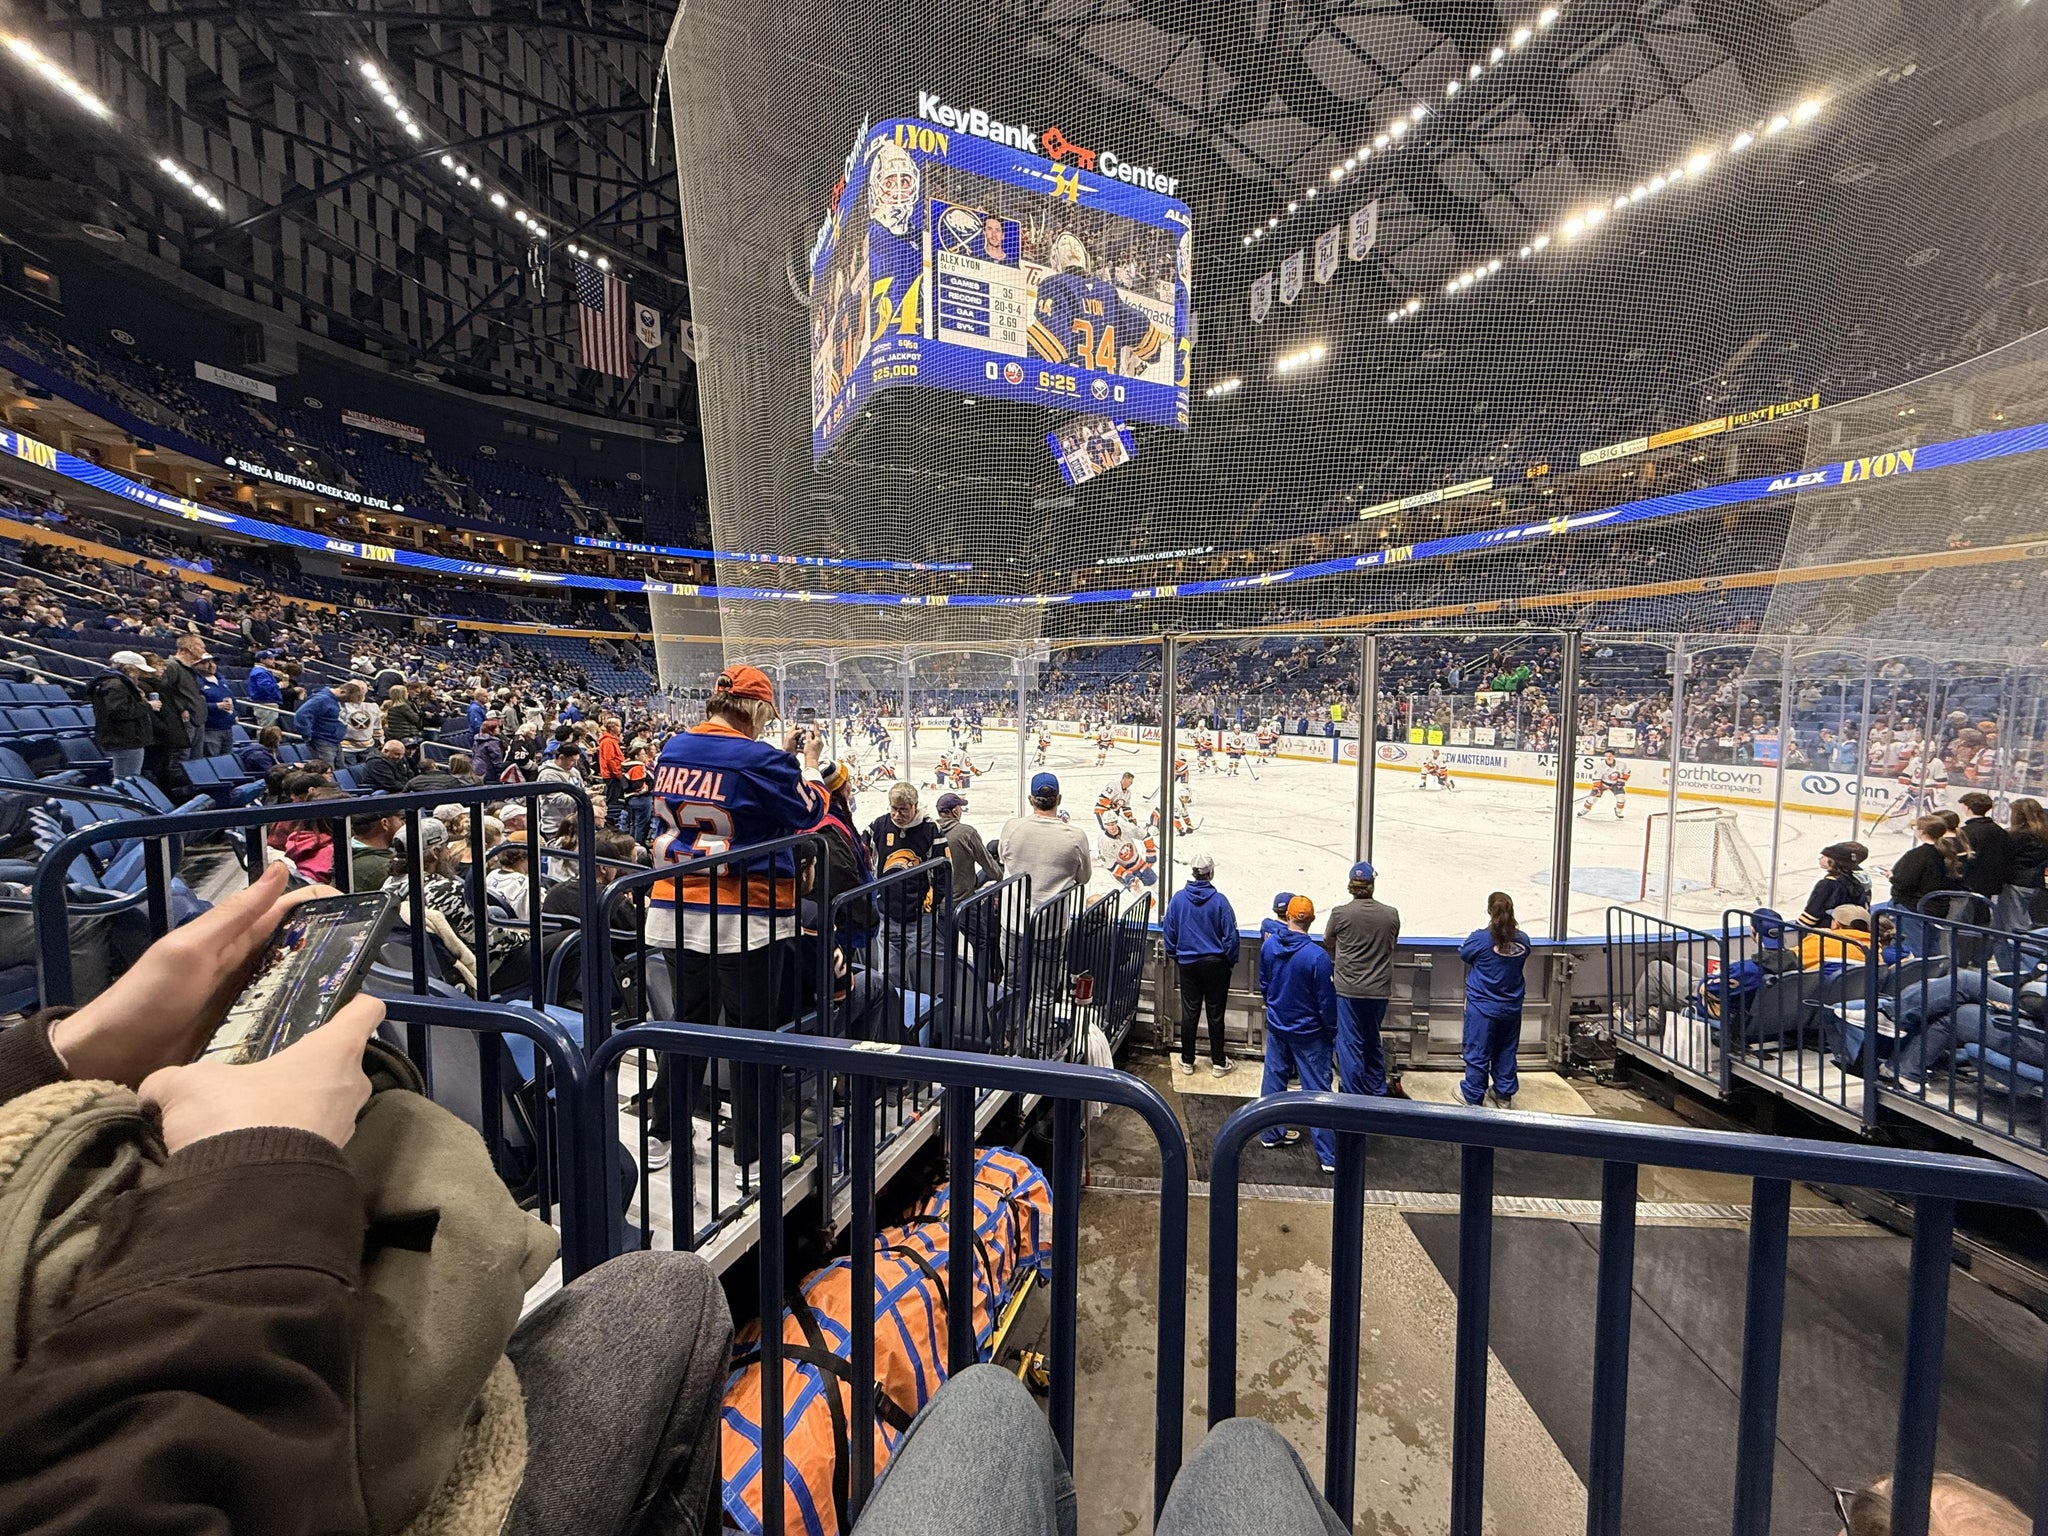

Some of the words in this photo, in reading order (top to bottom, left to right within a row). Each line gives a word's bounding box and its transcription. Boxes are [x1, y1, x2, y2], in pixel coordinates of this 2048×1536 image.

[894, 124, 949, 158] LYON
[919, 91, 1037, 152] KeyBank
[1099, 151, 1179, 197] Center
[1049, 163, 1080, 202] 34
[940, 252, 959, 265] ALEX
[961, 257, 980, 270] LYON
[950, 278, 980, 290] GAMES
[1003, 287, 1013, 300] 35
[870, 273, 924, 343] 34
[948, 291, 982, 305] RECORD
[994, 300, 1021, 316] 20-9-4
[1082, 297, 1104, 317] LYON
[956, 308, 975, 318] GAA
[999, 316, 1017, 328] 2.69
[956, 322, 975, 332] SV%
[1000, 331, 1016, 342] .910
[1071, 317, 1117, 375] 34
[887, 353, 922, 362] JACKPOT
[873, 364, 918, 382] $25,000
[985, 361, 998, 381] 0
[1039, 371, 1076, 392] 6:25
[1113, 385, 1125, 402] 0
[347, 409, 370, 421] NEED
[1775, 398, 1811, 414] HUNT
[1735, 408, 1769, 425] HUNT
[17, 434, 57, 470] LYON
[1599, 447, 1618, 459] BIG
[1767, 471, 1828, 492] ALEX
[1840, 449, 1918, 484] LYON
[239, 459, 273, 480] SENECA
[274, 470, 315, 491] BUFFALO
[316, 481, 343, 499] CREEK
[343, 491, 361, 504] 300
[363, 496, 391, 510] LEVEL
[325, 539, 355, 553] ALEX
[361, 543, 396, 563] LYON
[598, 540, 611, 548] OTT
[1187, 547, 1204, 556] LEVEL
[1355, 554, 1379, 566] ALEX
[1384, 545, 1413, 564] LYON
[642, 583, 667, 592] ALEX
[672, 584, 699, 596] LYON
[1131, 590, 1152, 598] ALEX
[1155, 586, 1178, 598] LYON
[925, 595, 949, 605] LYON
[1457, 753, 1502, 767] AMSTERDAM
[654, 766, 727, 801] BARZAL
[1710, 782, 1762, 794] companies
